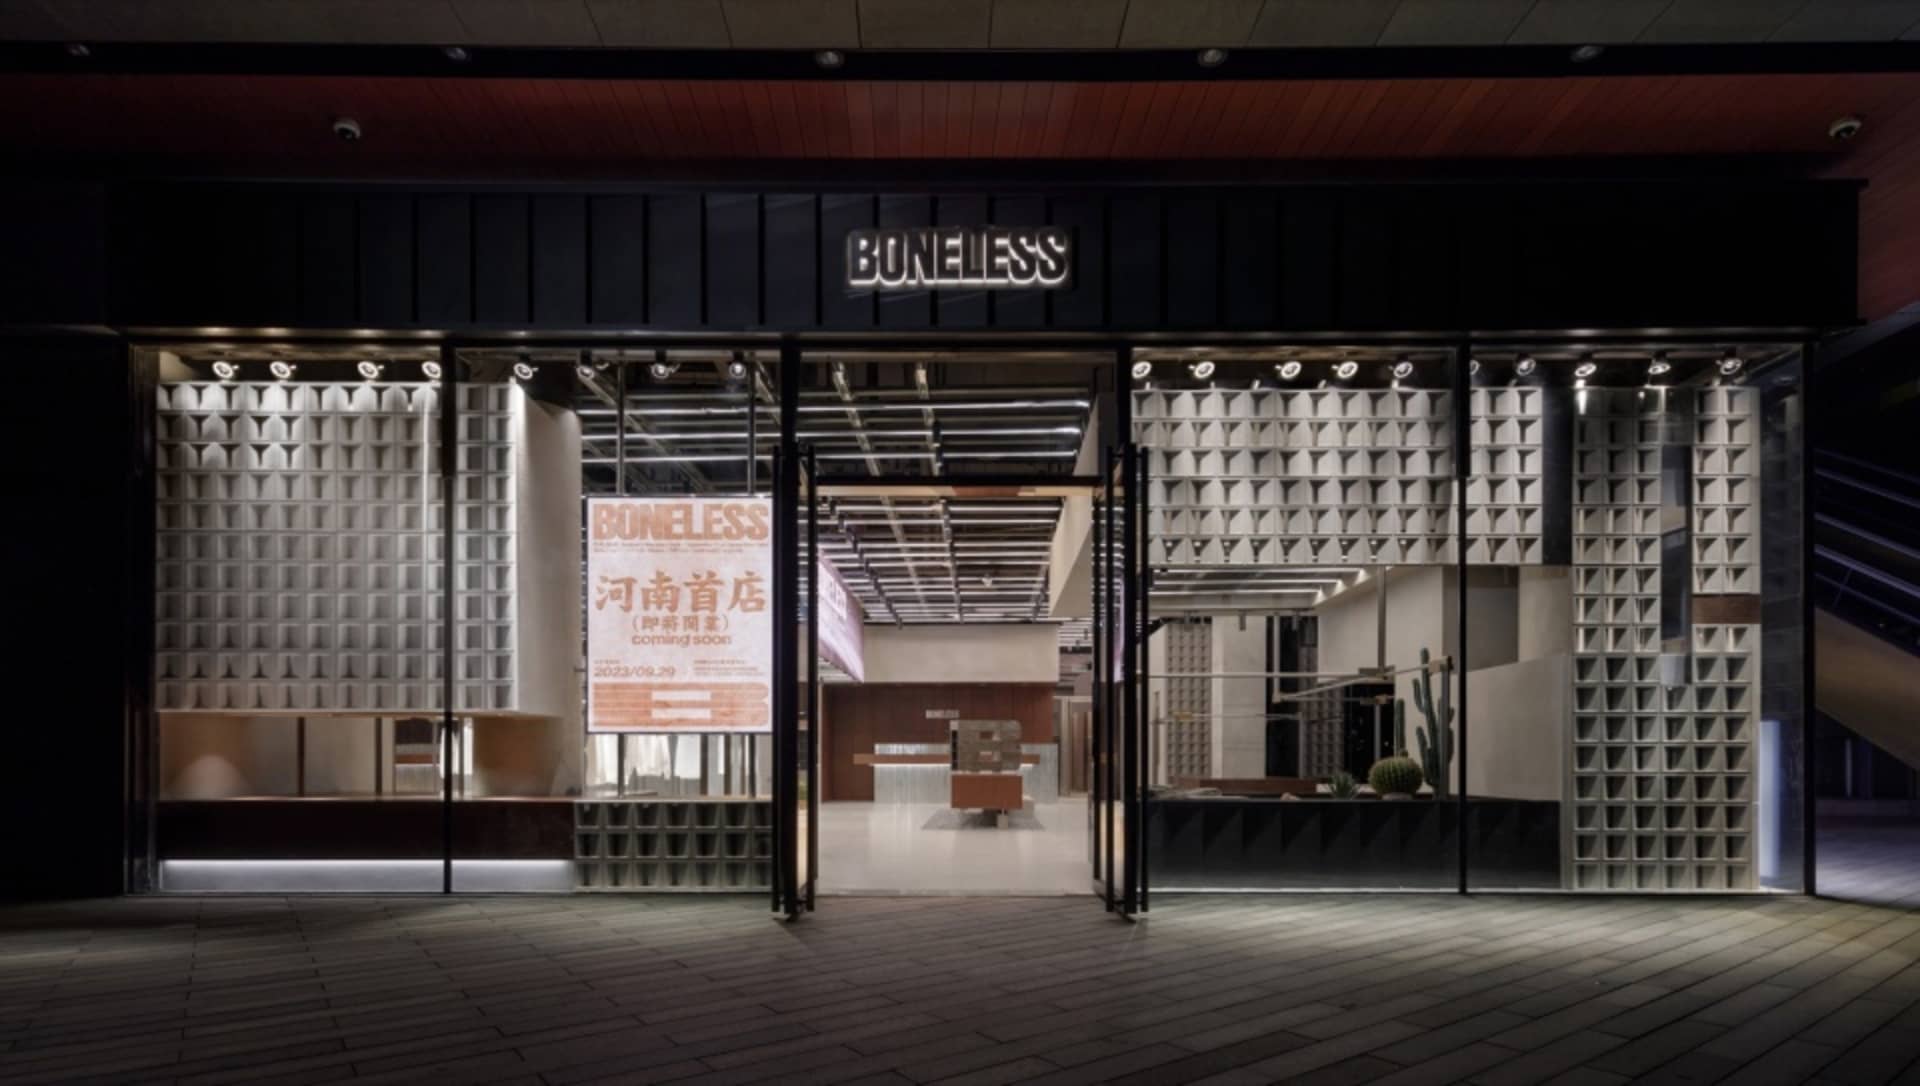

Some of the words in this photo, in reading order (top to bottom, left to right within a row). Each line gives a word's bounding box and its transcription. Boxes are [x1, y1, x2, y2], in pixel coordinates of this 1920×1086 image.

[848, 230, 1068, 285] BONELESS
[593, 503, 769, 541] BONELESS
[595, 571, 766, 613] 河南首店
[632, 634, 690, 648] coming
[693, 635, 732, 646] soon
